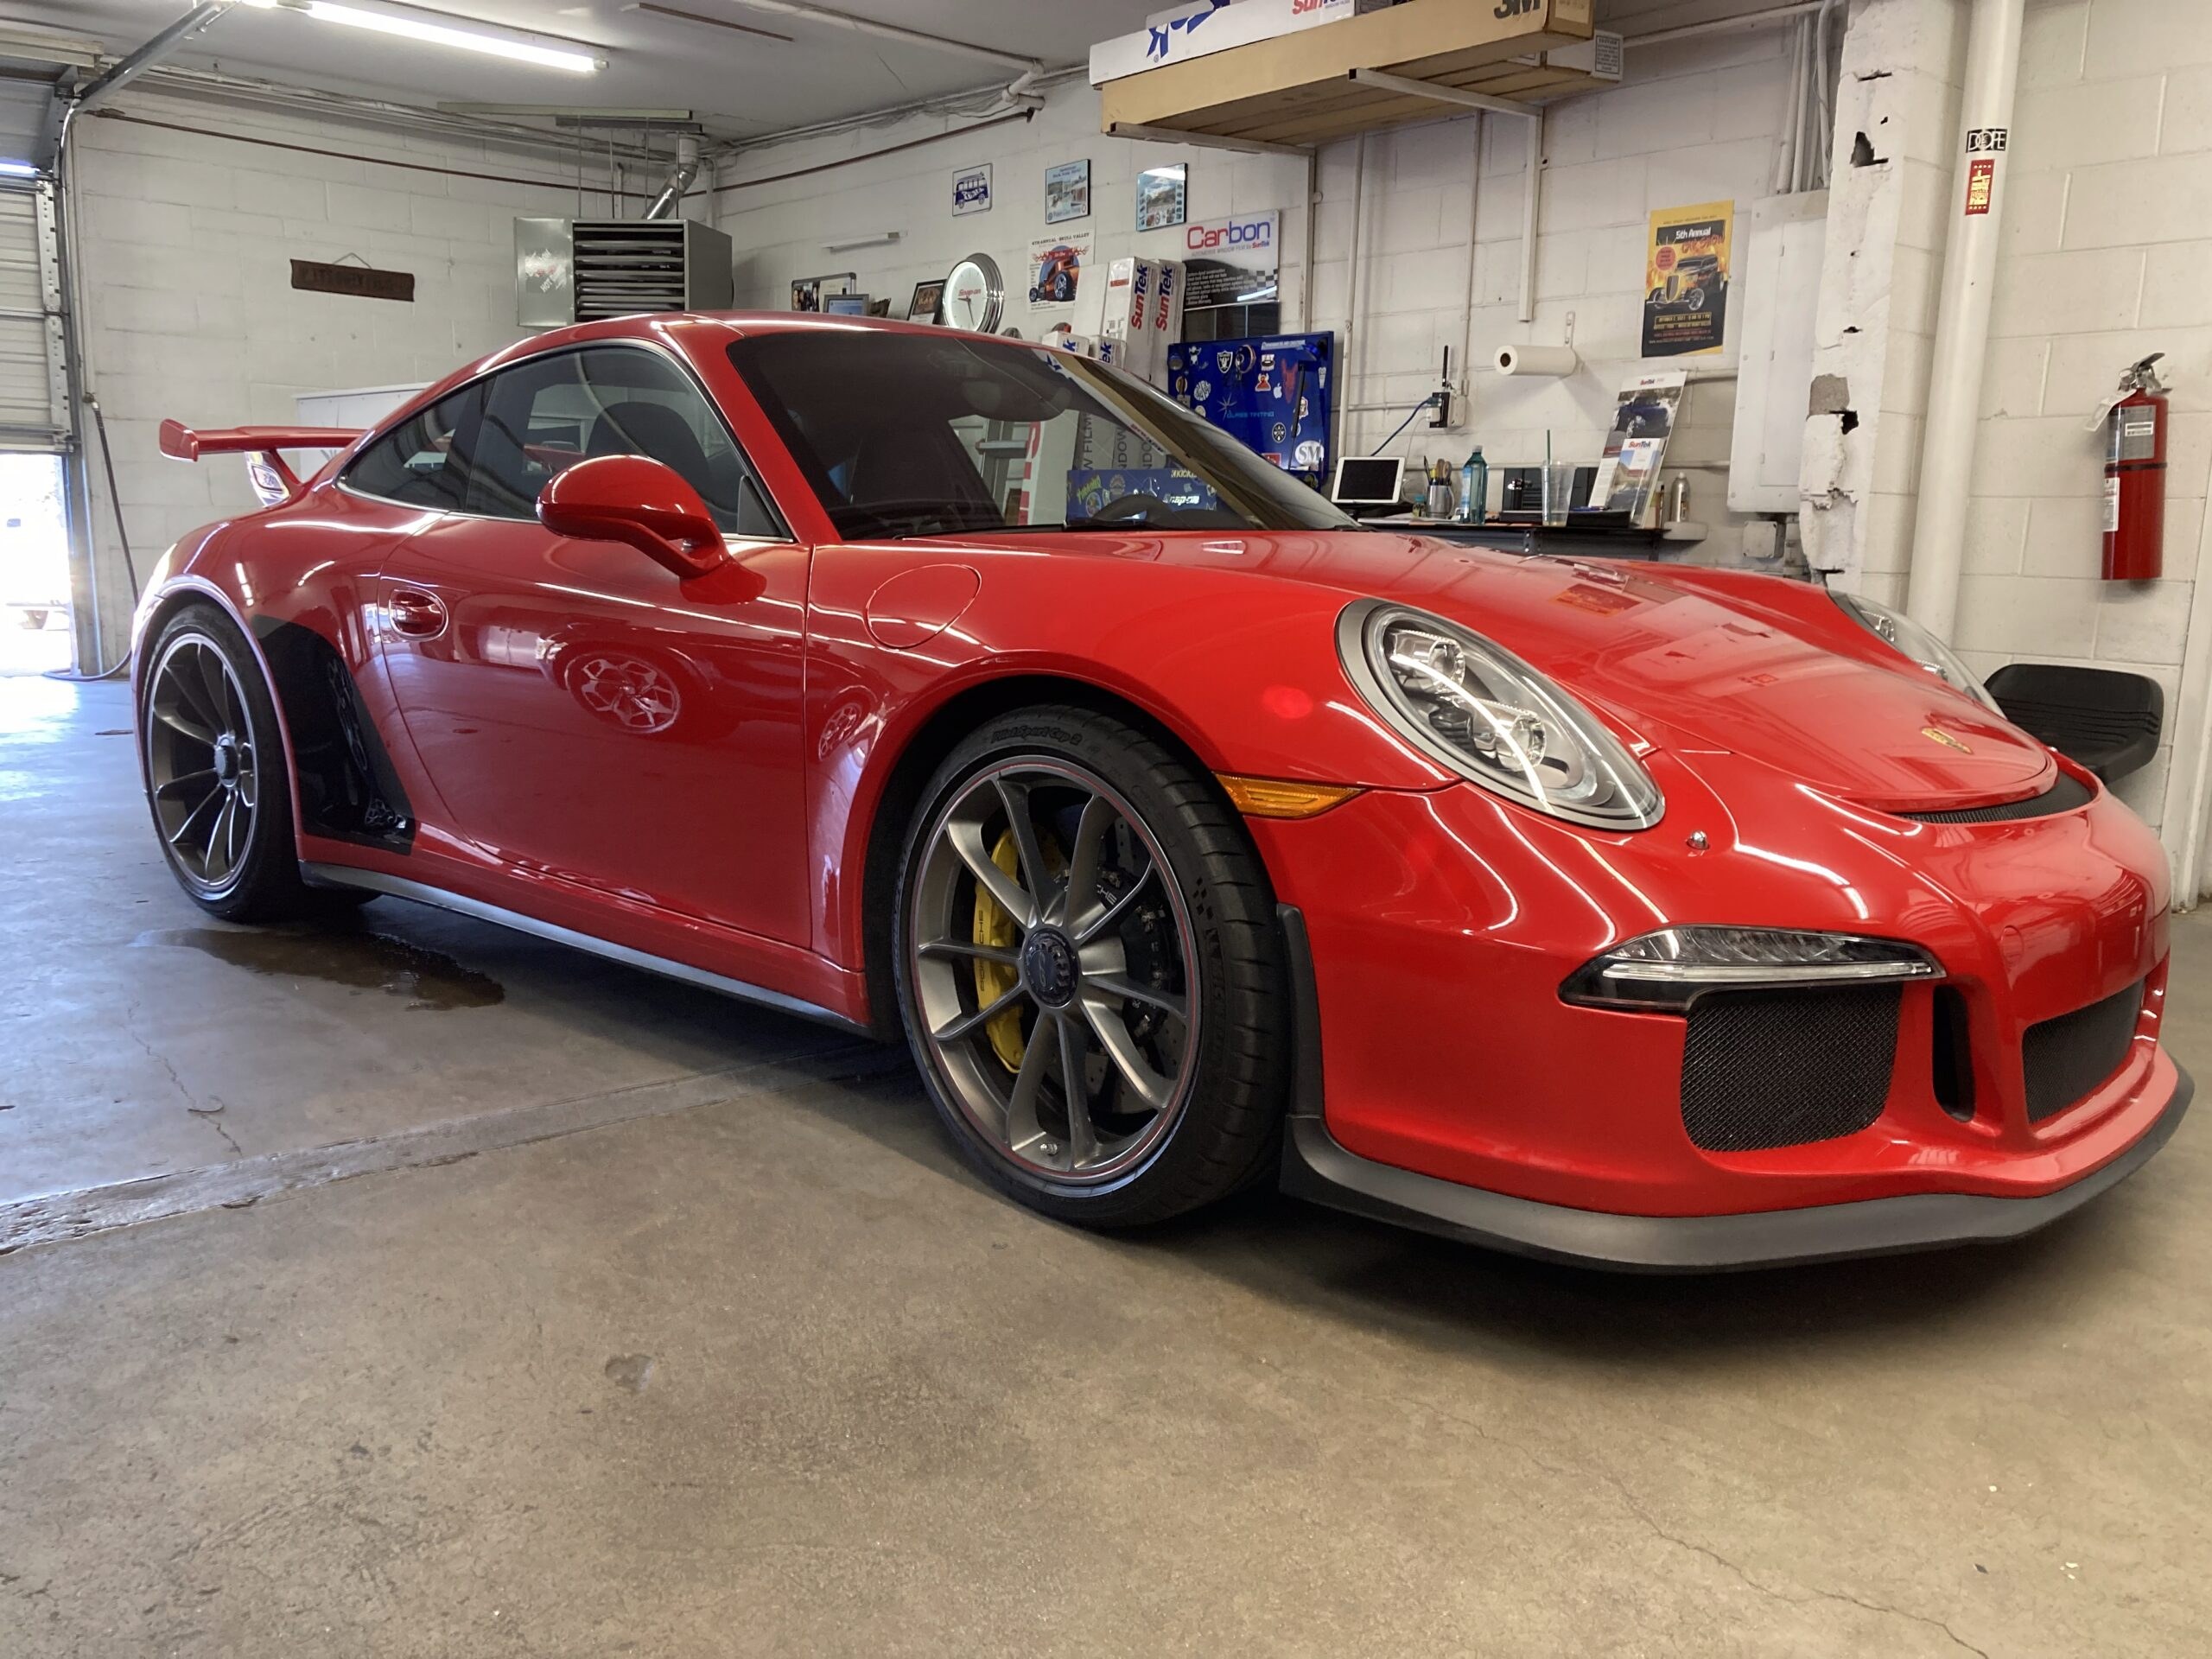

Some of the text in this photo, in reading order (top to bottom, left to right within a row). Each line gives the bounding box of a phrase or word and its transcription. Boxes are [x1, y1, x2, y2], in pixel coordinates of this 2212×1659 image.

[1494, 0, 1541, 19] 3M
[1967, 130, 2006, 151] DOPE
[1187, 220, 1271, 250] Carbon
[1675, 226, 1712, 240] 5th Annual
[1252, 240, 1270, 249] SunTek
[1131, 263, 1148, 330] SunTek
[1155, 265, 1173, 332] SunTek
[1299, 445, 1321, 462] SM
[1628, 441, 1651, 449] SunTek
[1162, 493, 1199, 506] Snap-on
[1071, 732, 1084, 746] 2
